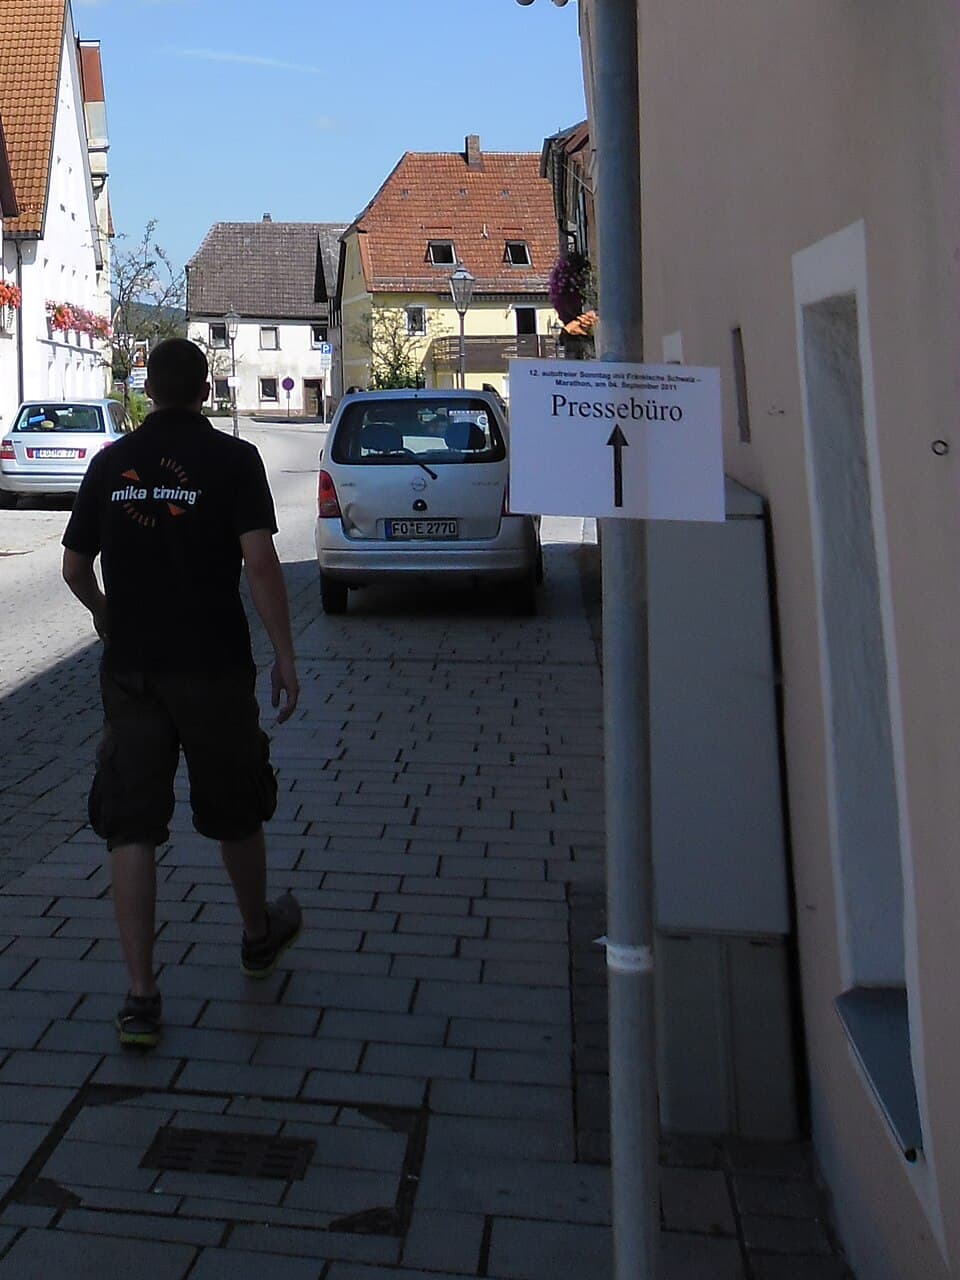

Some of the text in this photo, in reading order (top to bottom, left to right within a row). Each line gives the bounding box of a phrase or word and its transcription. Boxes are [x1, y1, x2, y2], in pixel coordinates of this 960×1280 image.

[579, 371, 611, 380] Sonntag
[621, 382, 660, 390] September
[551, 394, 683, 422] Pressebüro
[111, 485, 197, 505] mika timing
[426, 522, 456, 534] 2770
